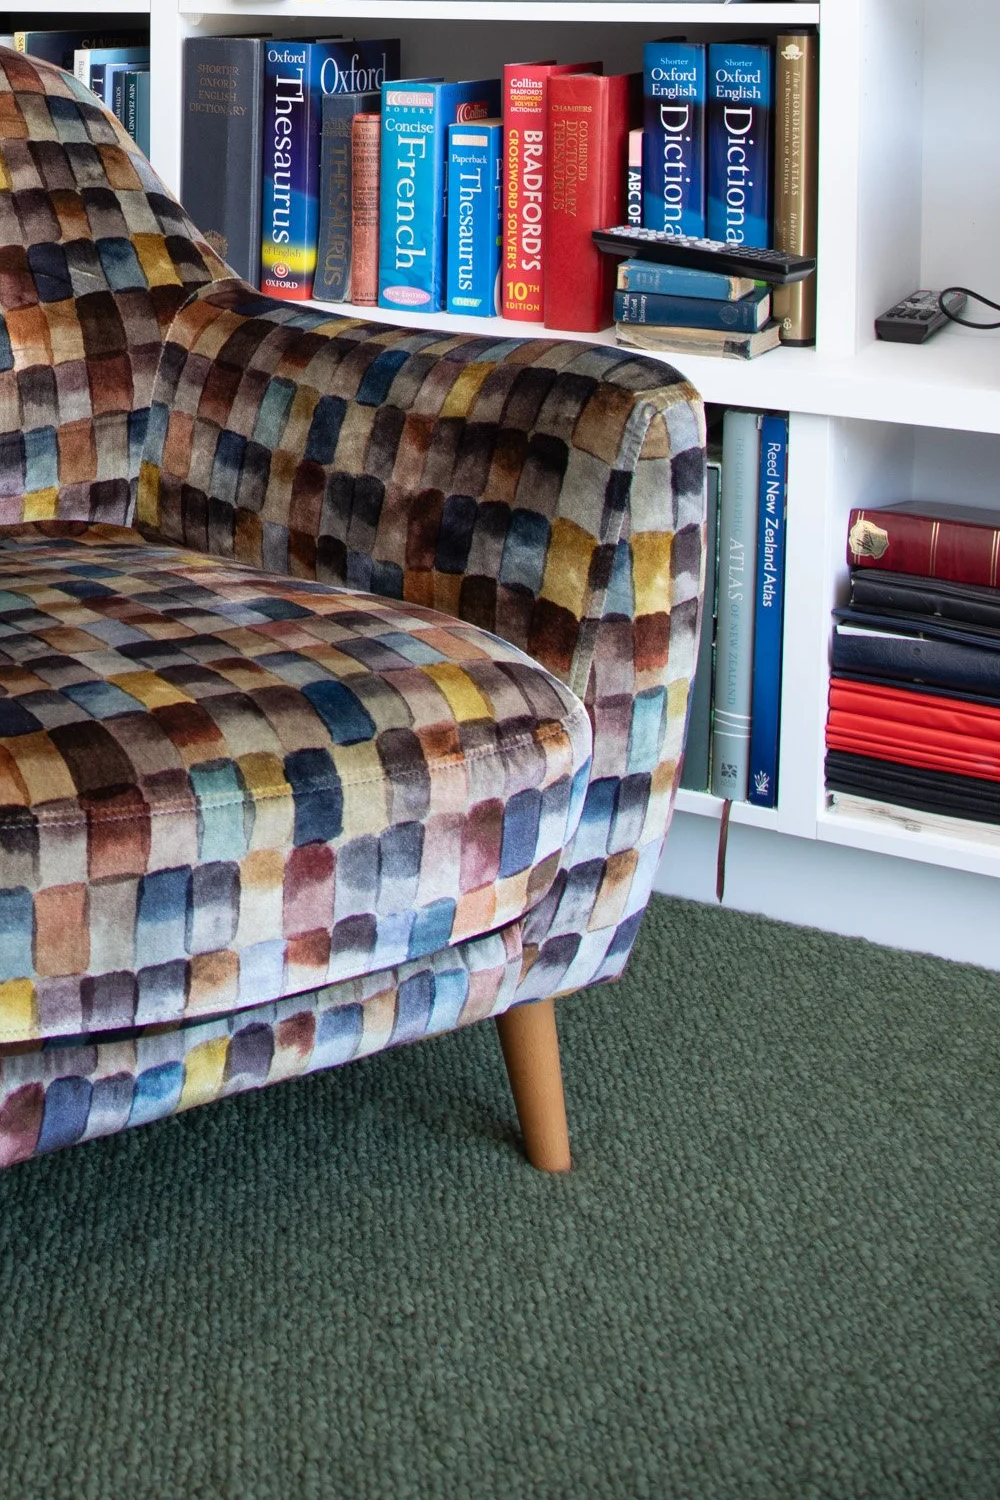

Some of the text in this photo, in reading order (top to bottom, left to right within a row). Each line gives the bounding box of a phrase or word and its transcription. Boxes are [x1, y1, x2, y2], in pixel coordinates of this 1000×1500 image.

[268, 50, 305, 65] Oxford
[660, 57, 689, 66] Shorter
[724, 58, 753, 68] Shorter
[197, 65, 240, 76] SHORTER
[321, 53, 386, 94] Oxford
[651, 67, 697, 83] Oxford
[715, 69, 761, 85] Oxford
[200, 78, 236, 88] OXFORD
[510, 78, 543, 89] Collins
[198, 90, 236, 102] ENGLISH
[510, 88, 543, 96] BRADFORD'S
[651, 84, 697, 98] English
[716, 86, 761, 101] English
[398, 93, 432, 105] Collins
[189, 103, 247, 116] DICTIONARY
[386, 106, 433, 115] ROBERT
[510, 106, 542, 114] DICTIONARY
[552, 104, 592, 113] CHAMBERS
[385, 118, 433, 134] Concise
[272, 68, 305, 244] Thesaurus
[578, 120, 589, 181] COMBINED
[452, 154, 487, 165] Paperback
[553, 121, 565, 211] THESAURUS
[565, 120, 578, 217] DICTIONARY
[660, 104, 691, 236] Dictiona
[723, 106, 753, 247] Dictiona
[395, 135, 426, 270] French
[507, 129, 518, 269] CROSSWORD SOLVER'S
[522, 130, 543, 271] BRADFORD'S
[628, 170, 641, 226] ABC OF
[324, 146, 347, 286] THESAURUS
[459, 169, 481, 291] Thesaurus
[266, 279, 298, 289] OXFORD
[506, 302, 540, 311] EDITION
[762, 442, 781, 607] Reed New Zealand Atlas
[727, 537, 747, 602] ATLAS
